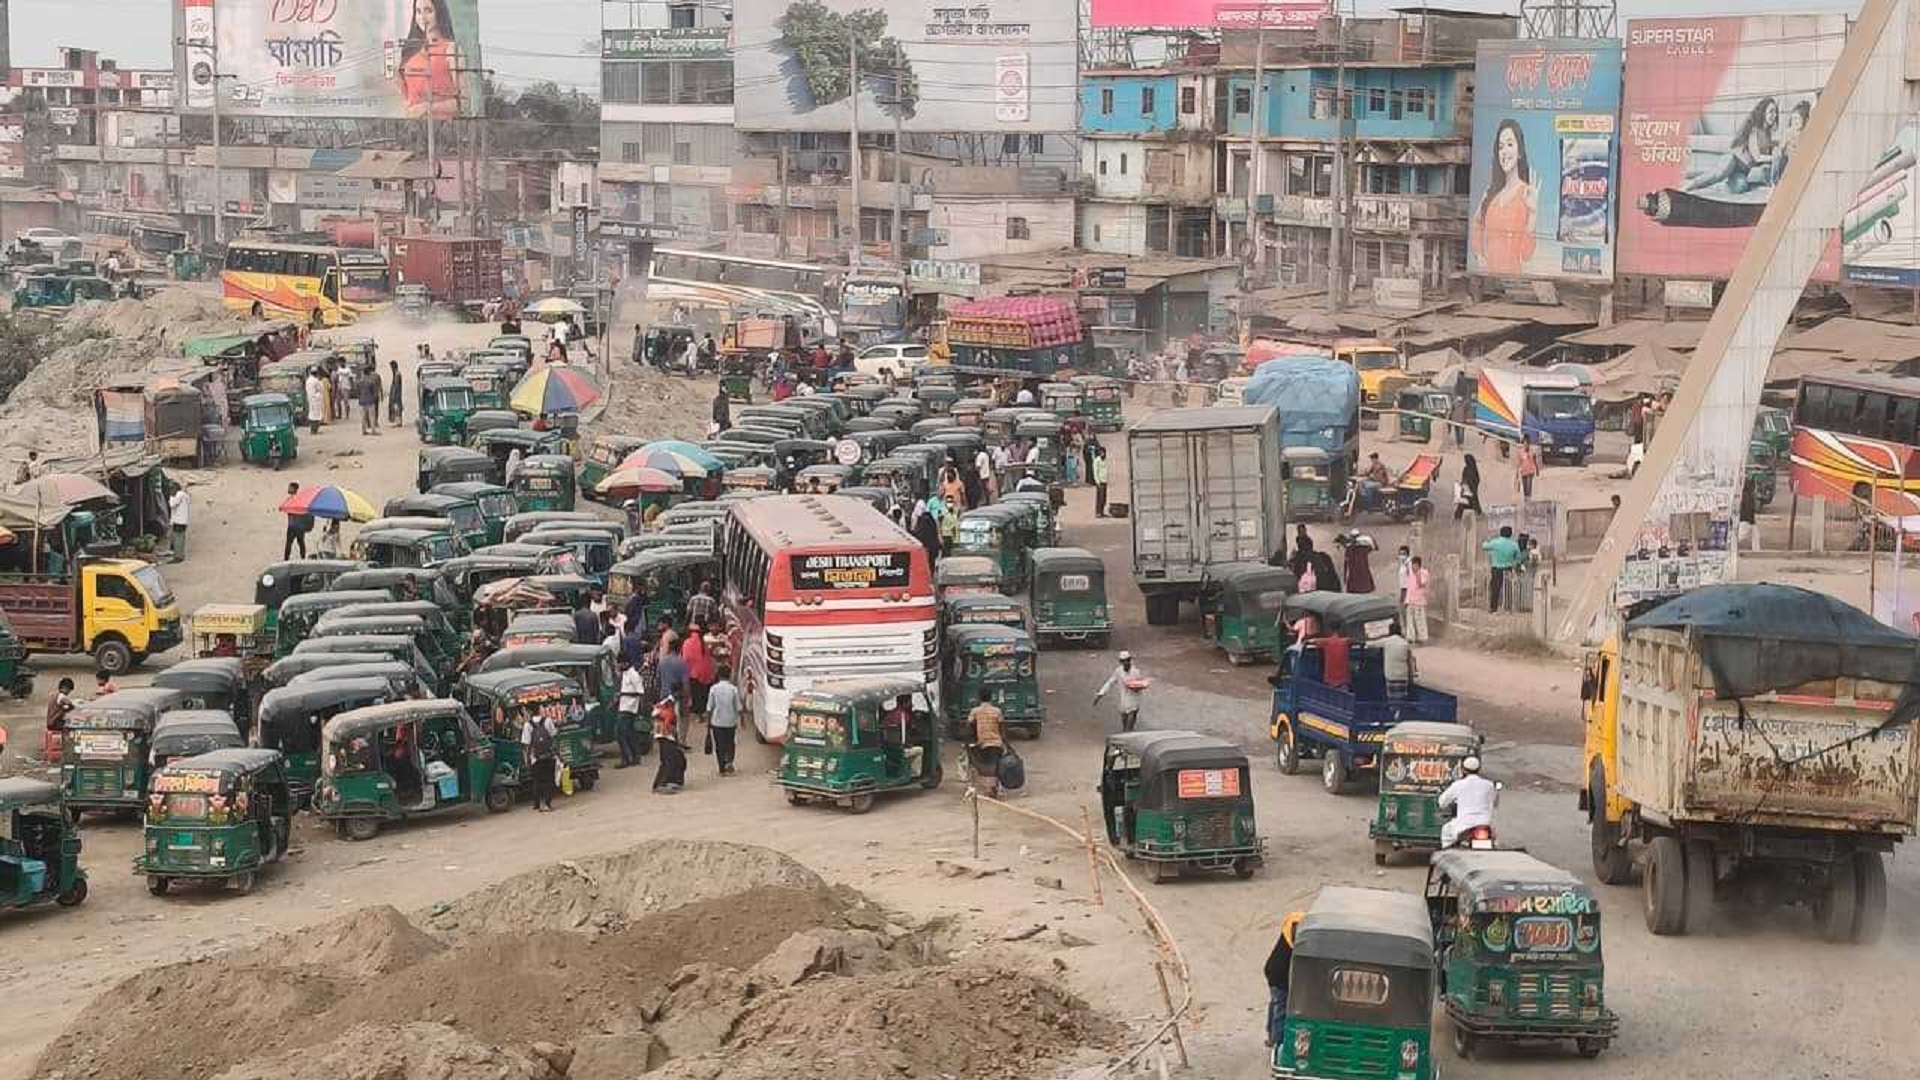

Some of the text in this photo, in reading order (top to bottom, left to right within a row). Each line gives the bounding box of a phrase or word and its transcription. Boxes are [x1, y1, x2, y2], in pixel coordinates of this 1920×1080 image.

[976, 23, 1030, 36] বাংলাদেশ
[1631, 27, 1714, 45] SUPER STAR
[265, 30, 345, 67] ঘামাচি
[835, 555, 892, 567] TRANSPORT
